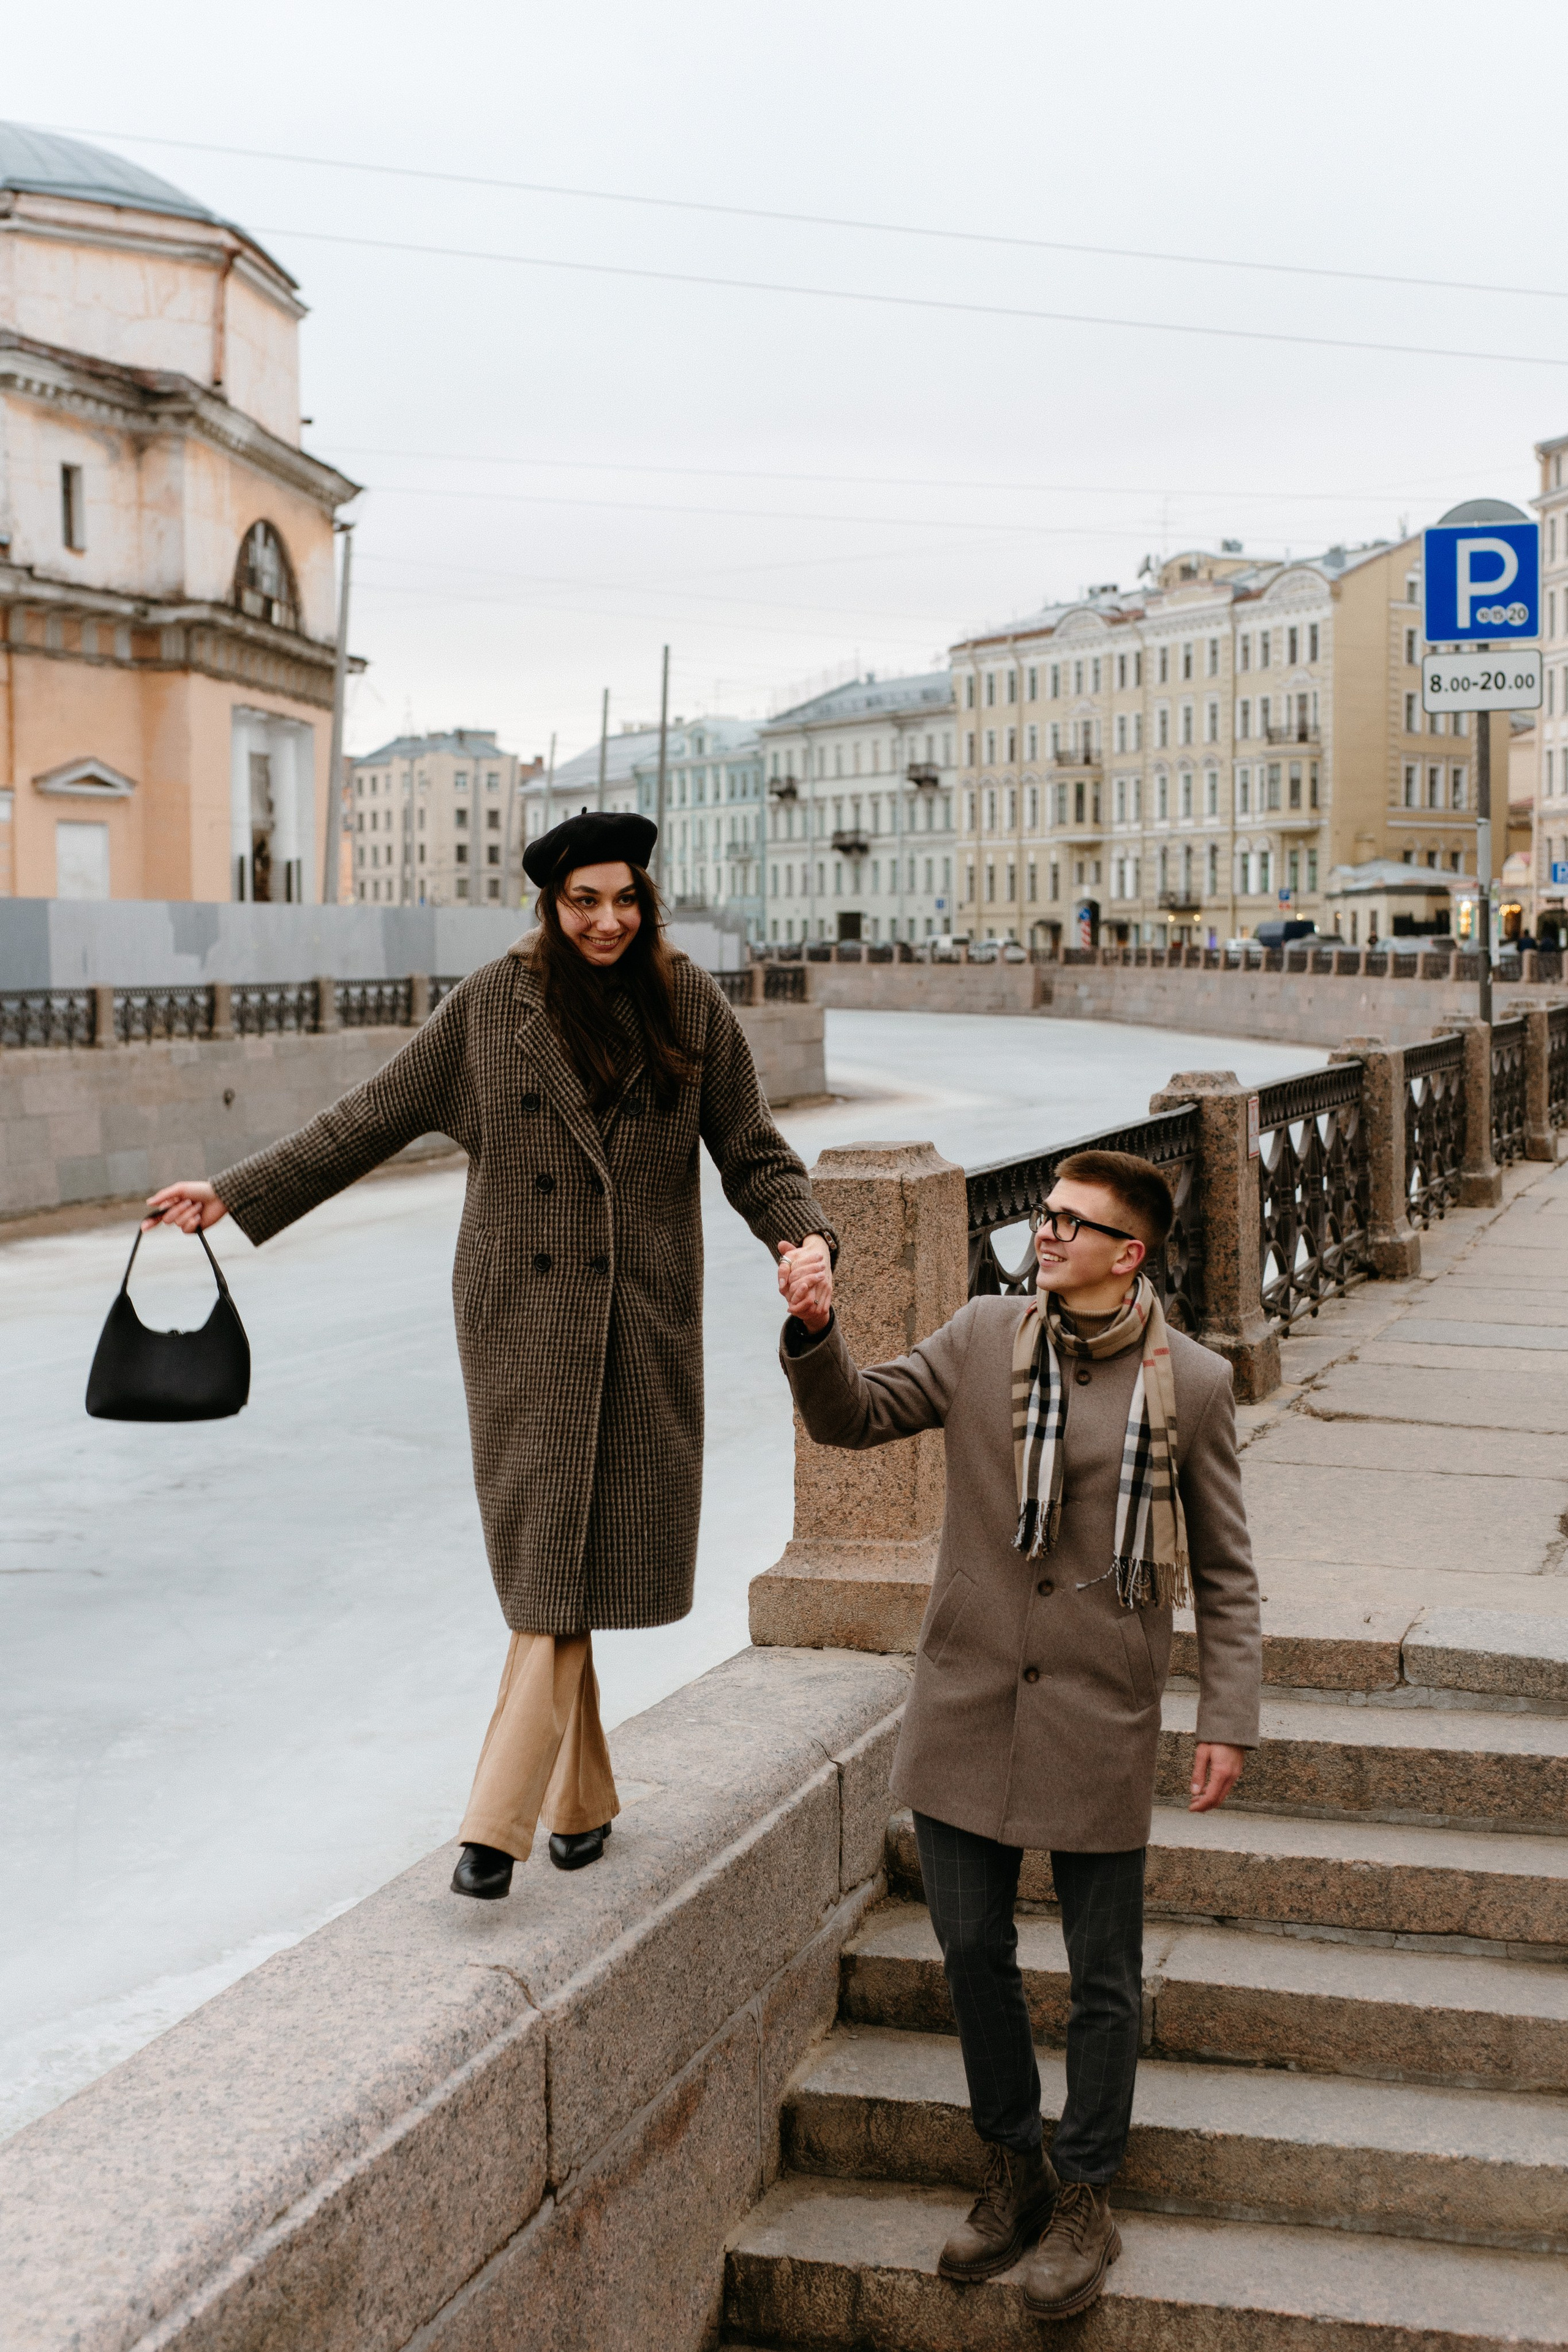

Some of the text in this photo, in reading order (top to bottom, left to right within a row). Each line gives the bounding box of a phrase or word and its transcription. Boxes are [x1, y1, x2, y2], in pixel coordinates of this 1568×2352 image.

[1457, 537, 1518, 628] P
[1509, 607, 1526, 620] 20
[1430, 671, 1535, 693] 8.00-20.00
